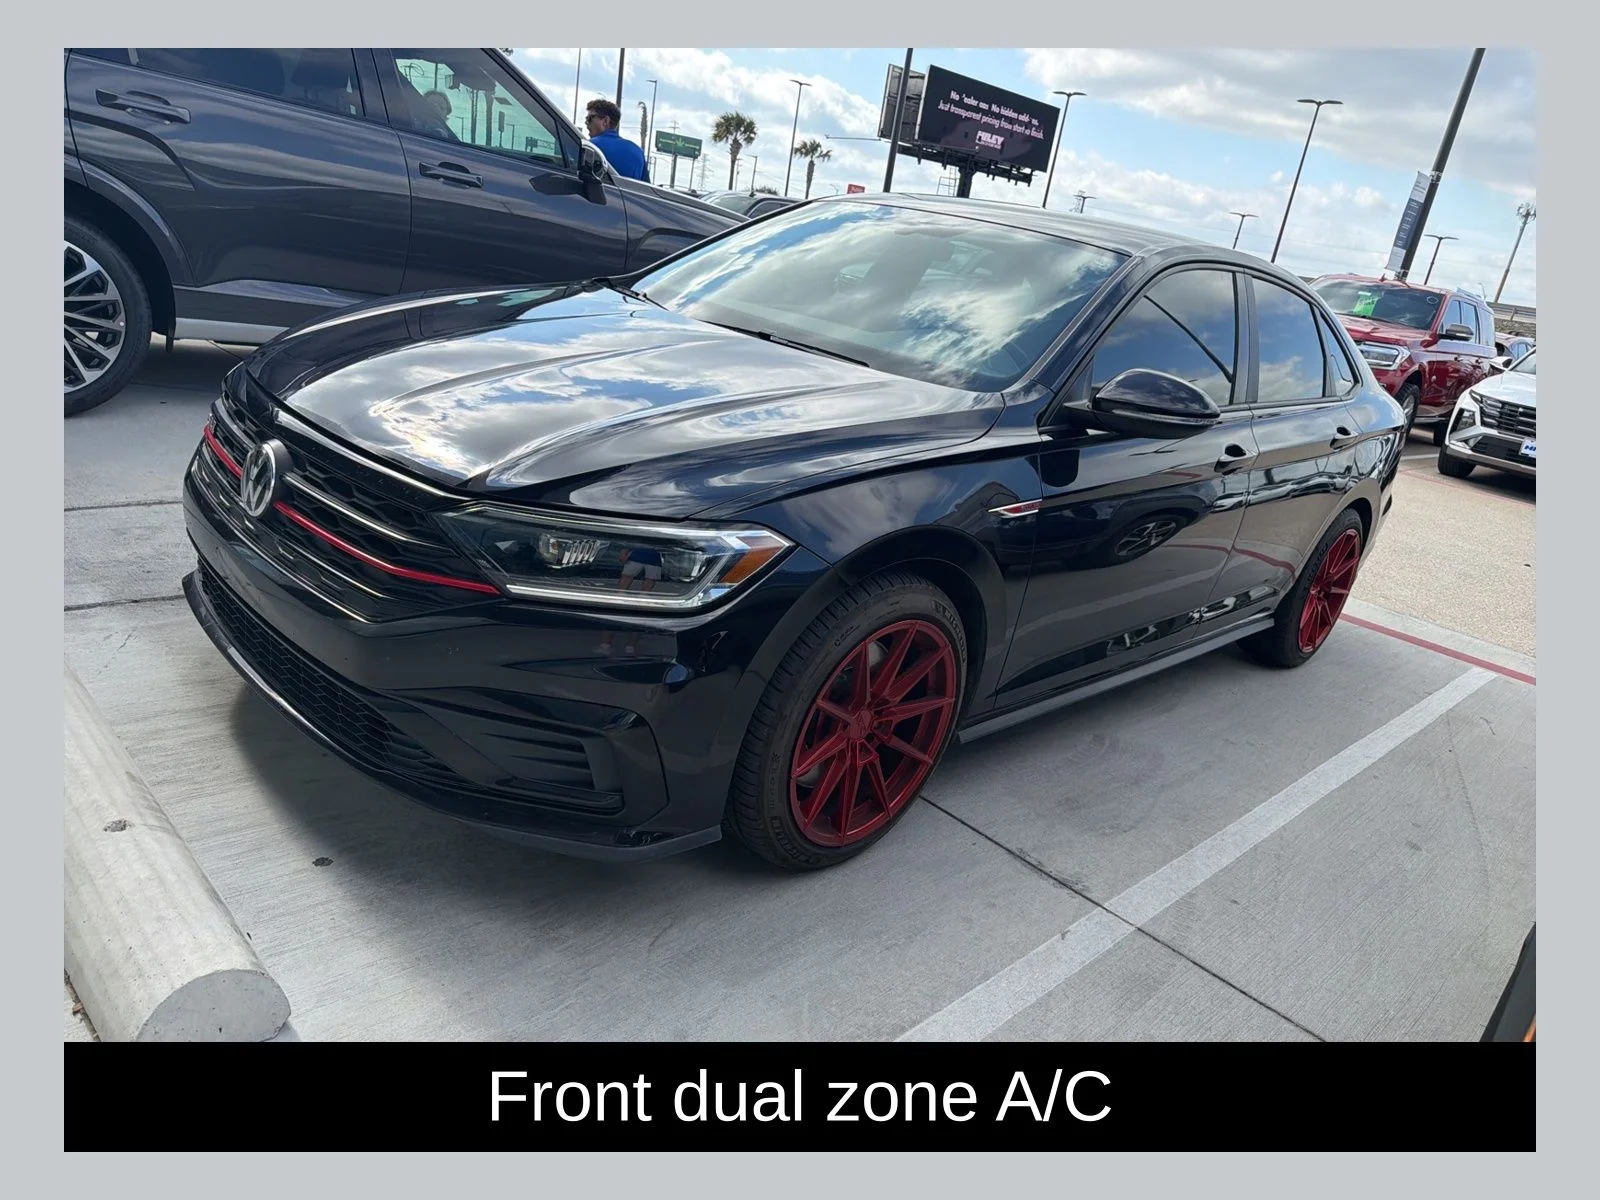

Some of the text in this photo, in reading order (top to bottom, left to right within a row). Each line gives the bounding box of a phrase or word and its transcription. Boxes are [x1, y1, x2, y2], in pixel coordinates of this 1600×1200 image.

[938, 99, 950, 112] Just
[950, 104, 982, 121] transparent
[981, 114, 1000, 129] pricing
[1000, 118, 1012, 130] from
[1012, 122, 1025, 134] start
[950, 90, 959, 101] No
[991, 103, 1000, 114] No
[1001, 106, 1018, 119] hidden
